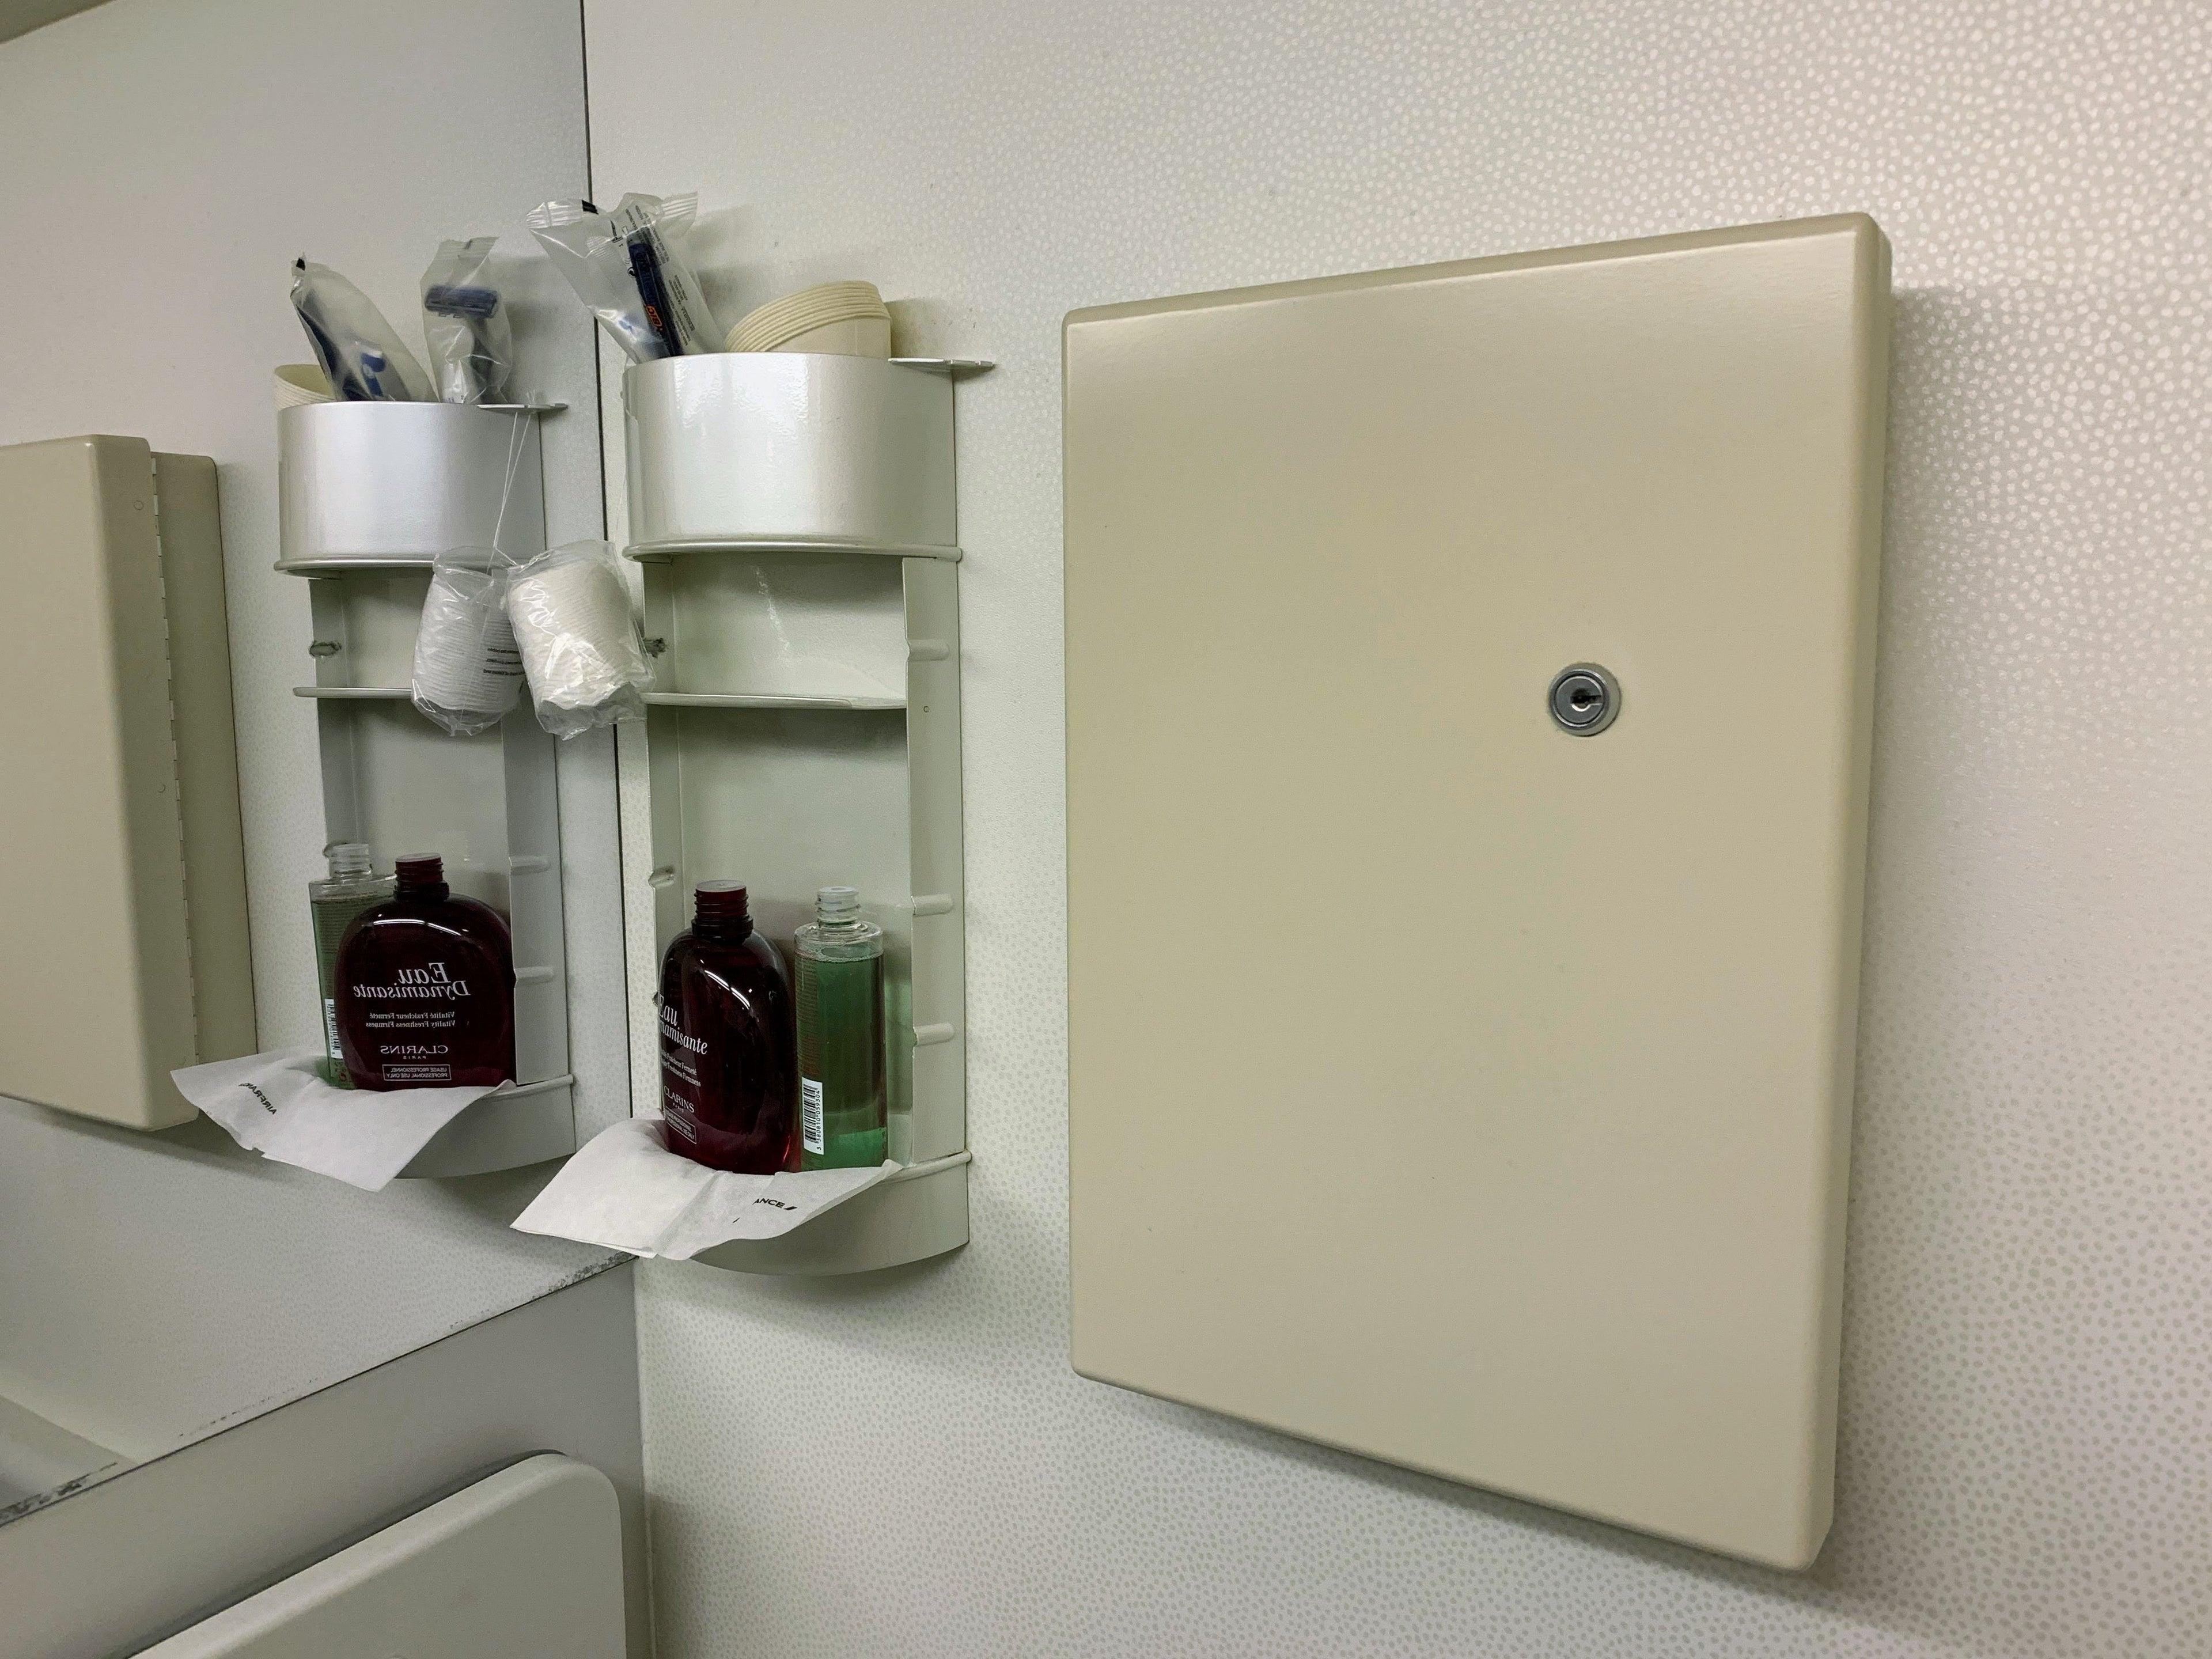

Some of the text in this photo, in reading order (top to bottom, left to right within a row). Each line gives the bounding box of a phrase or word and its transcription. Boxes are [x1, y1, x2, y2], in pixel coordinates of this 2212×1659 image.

[646, 306, 661, 325] BIC
[661, 1020, 707, 1055] namisante
[664, 1085, 694, 1113] CLARINS
